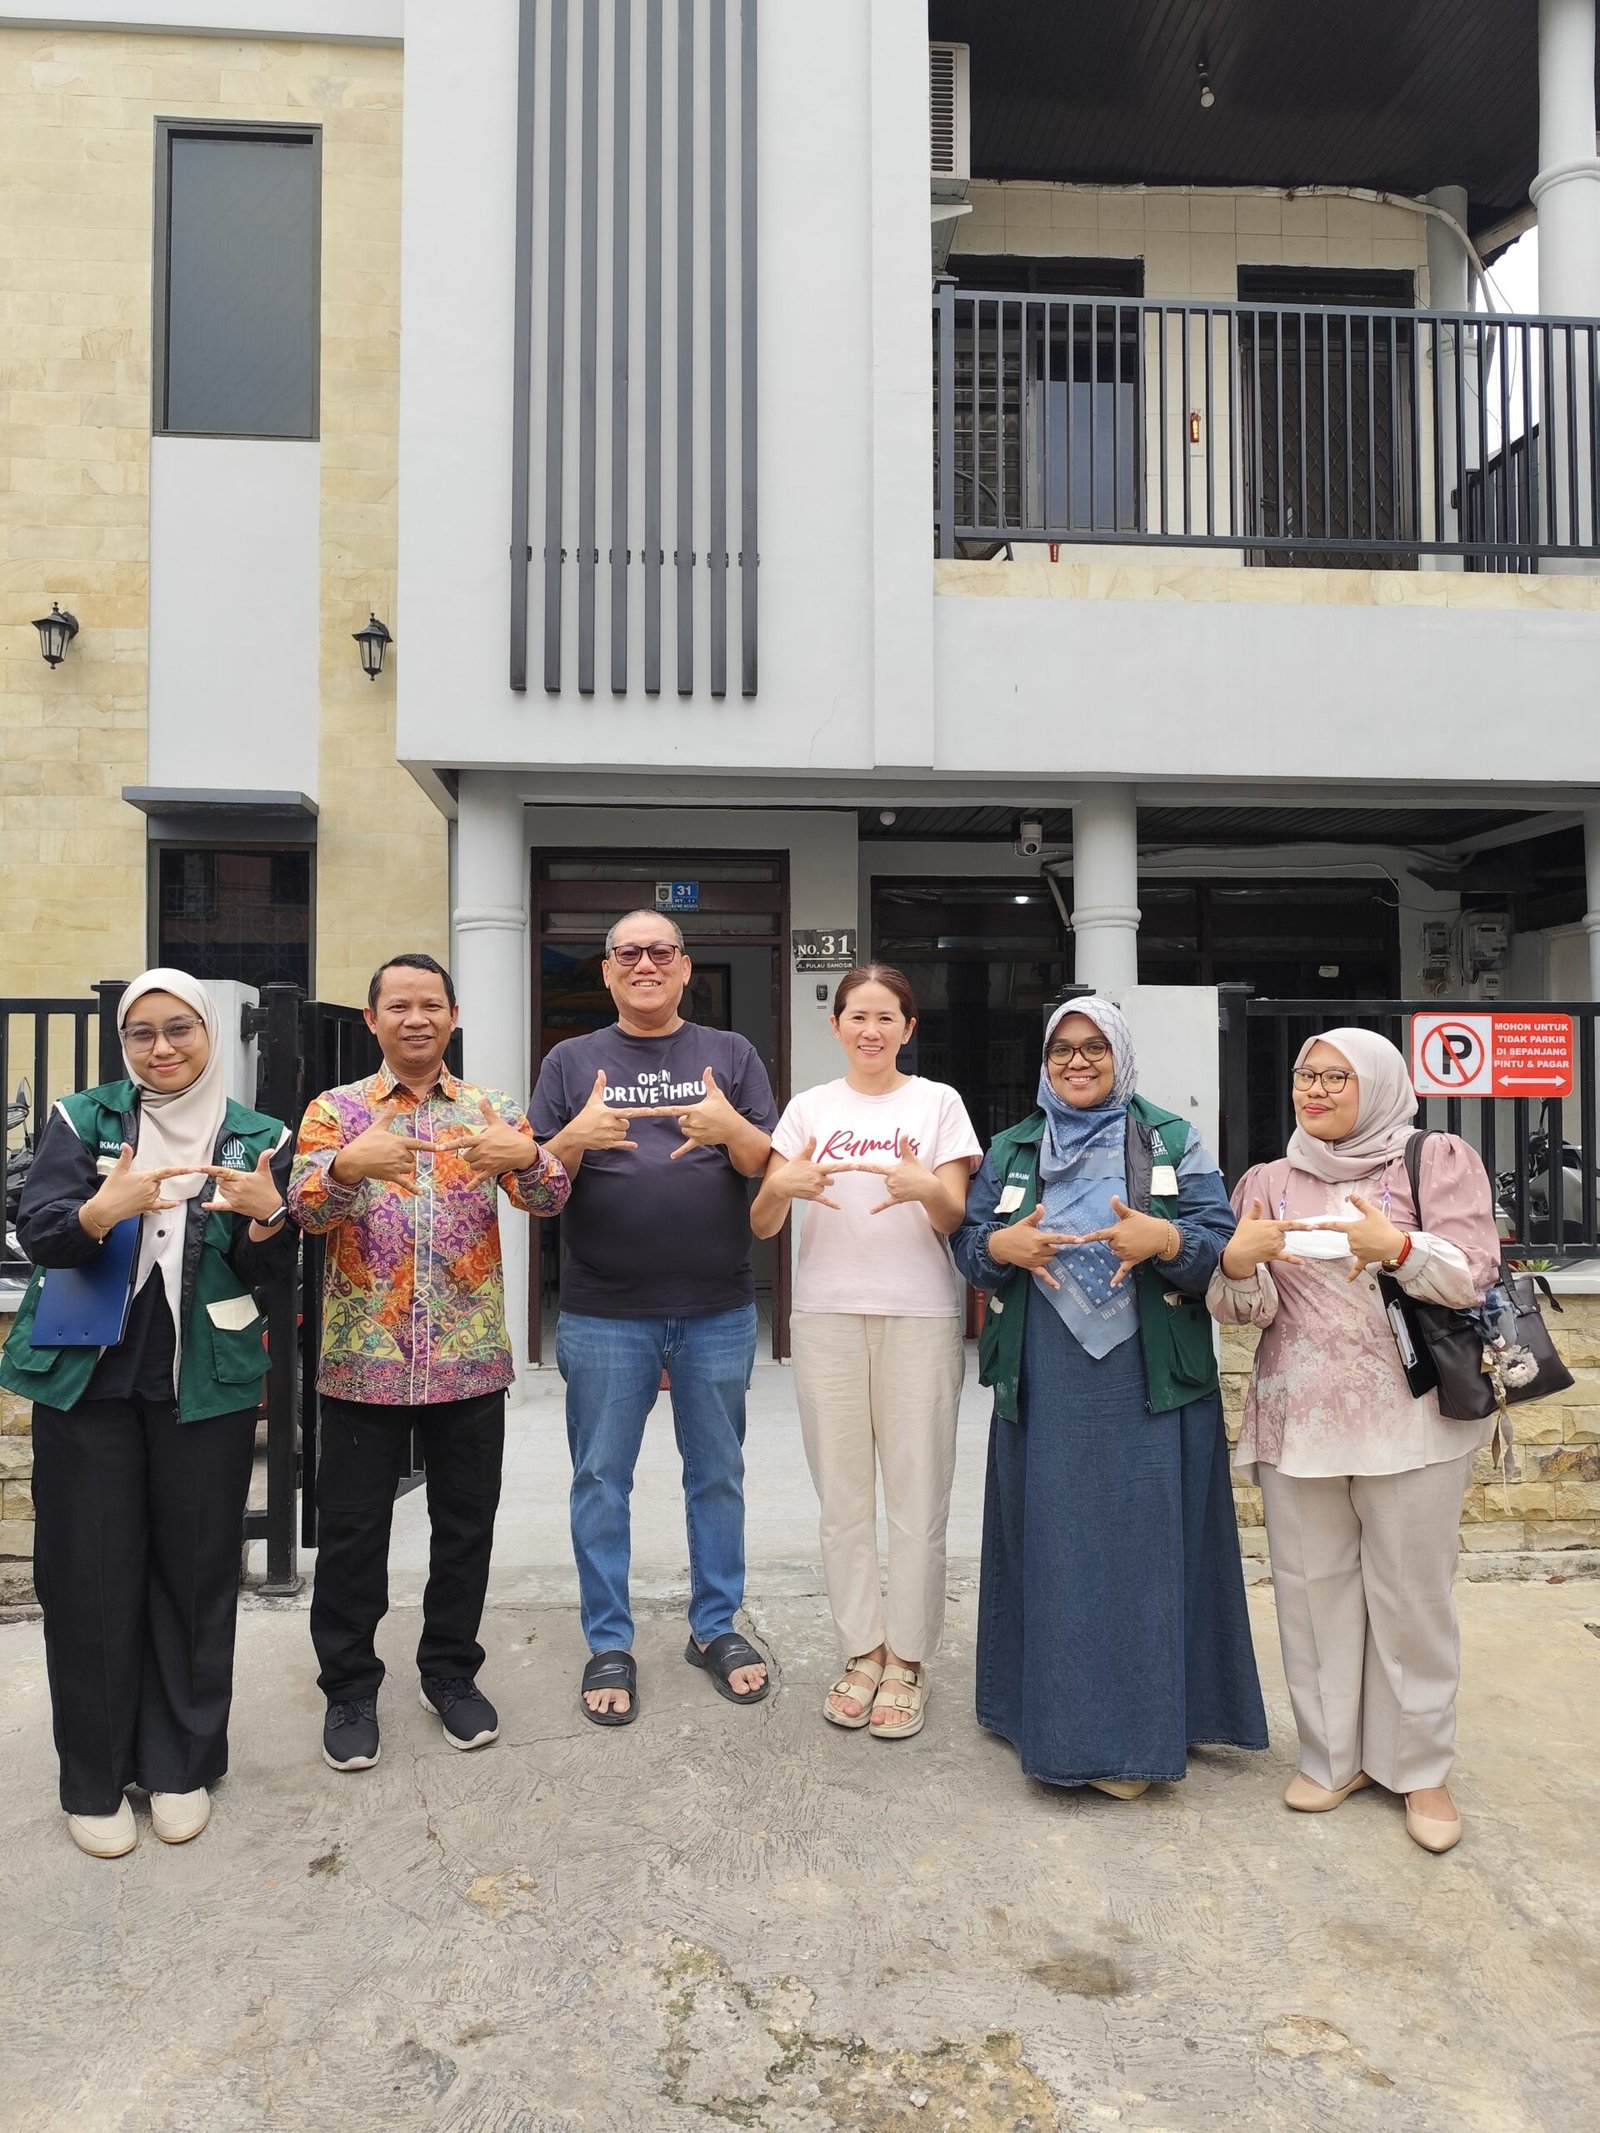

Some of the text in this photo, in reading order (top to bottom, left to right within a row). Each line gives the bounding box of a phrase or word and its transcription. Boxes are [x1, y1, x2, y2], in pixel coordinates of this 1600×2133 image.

[677, 885, 691, 896] 31
[1494, 1022, 1569, 1031] MOHON UNTUK
[1497, 1035, 1566, 1043] TIDAK PARKIR
[1496, 1047, 1567, 1056] DI SEPANJANG
[1494, 1060, 1570, 1068] PINTU & PAGAR
[637, 1069, 671, 1086] OPEN
